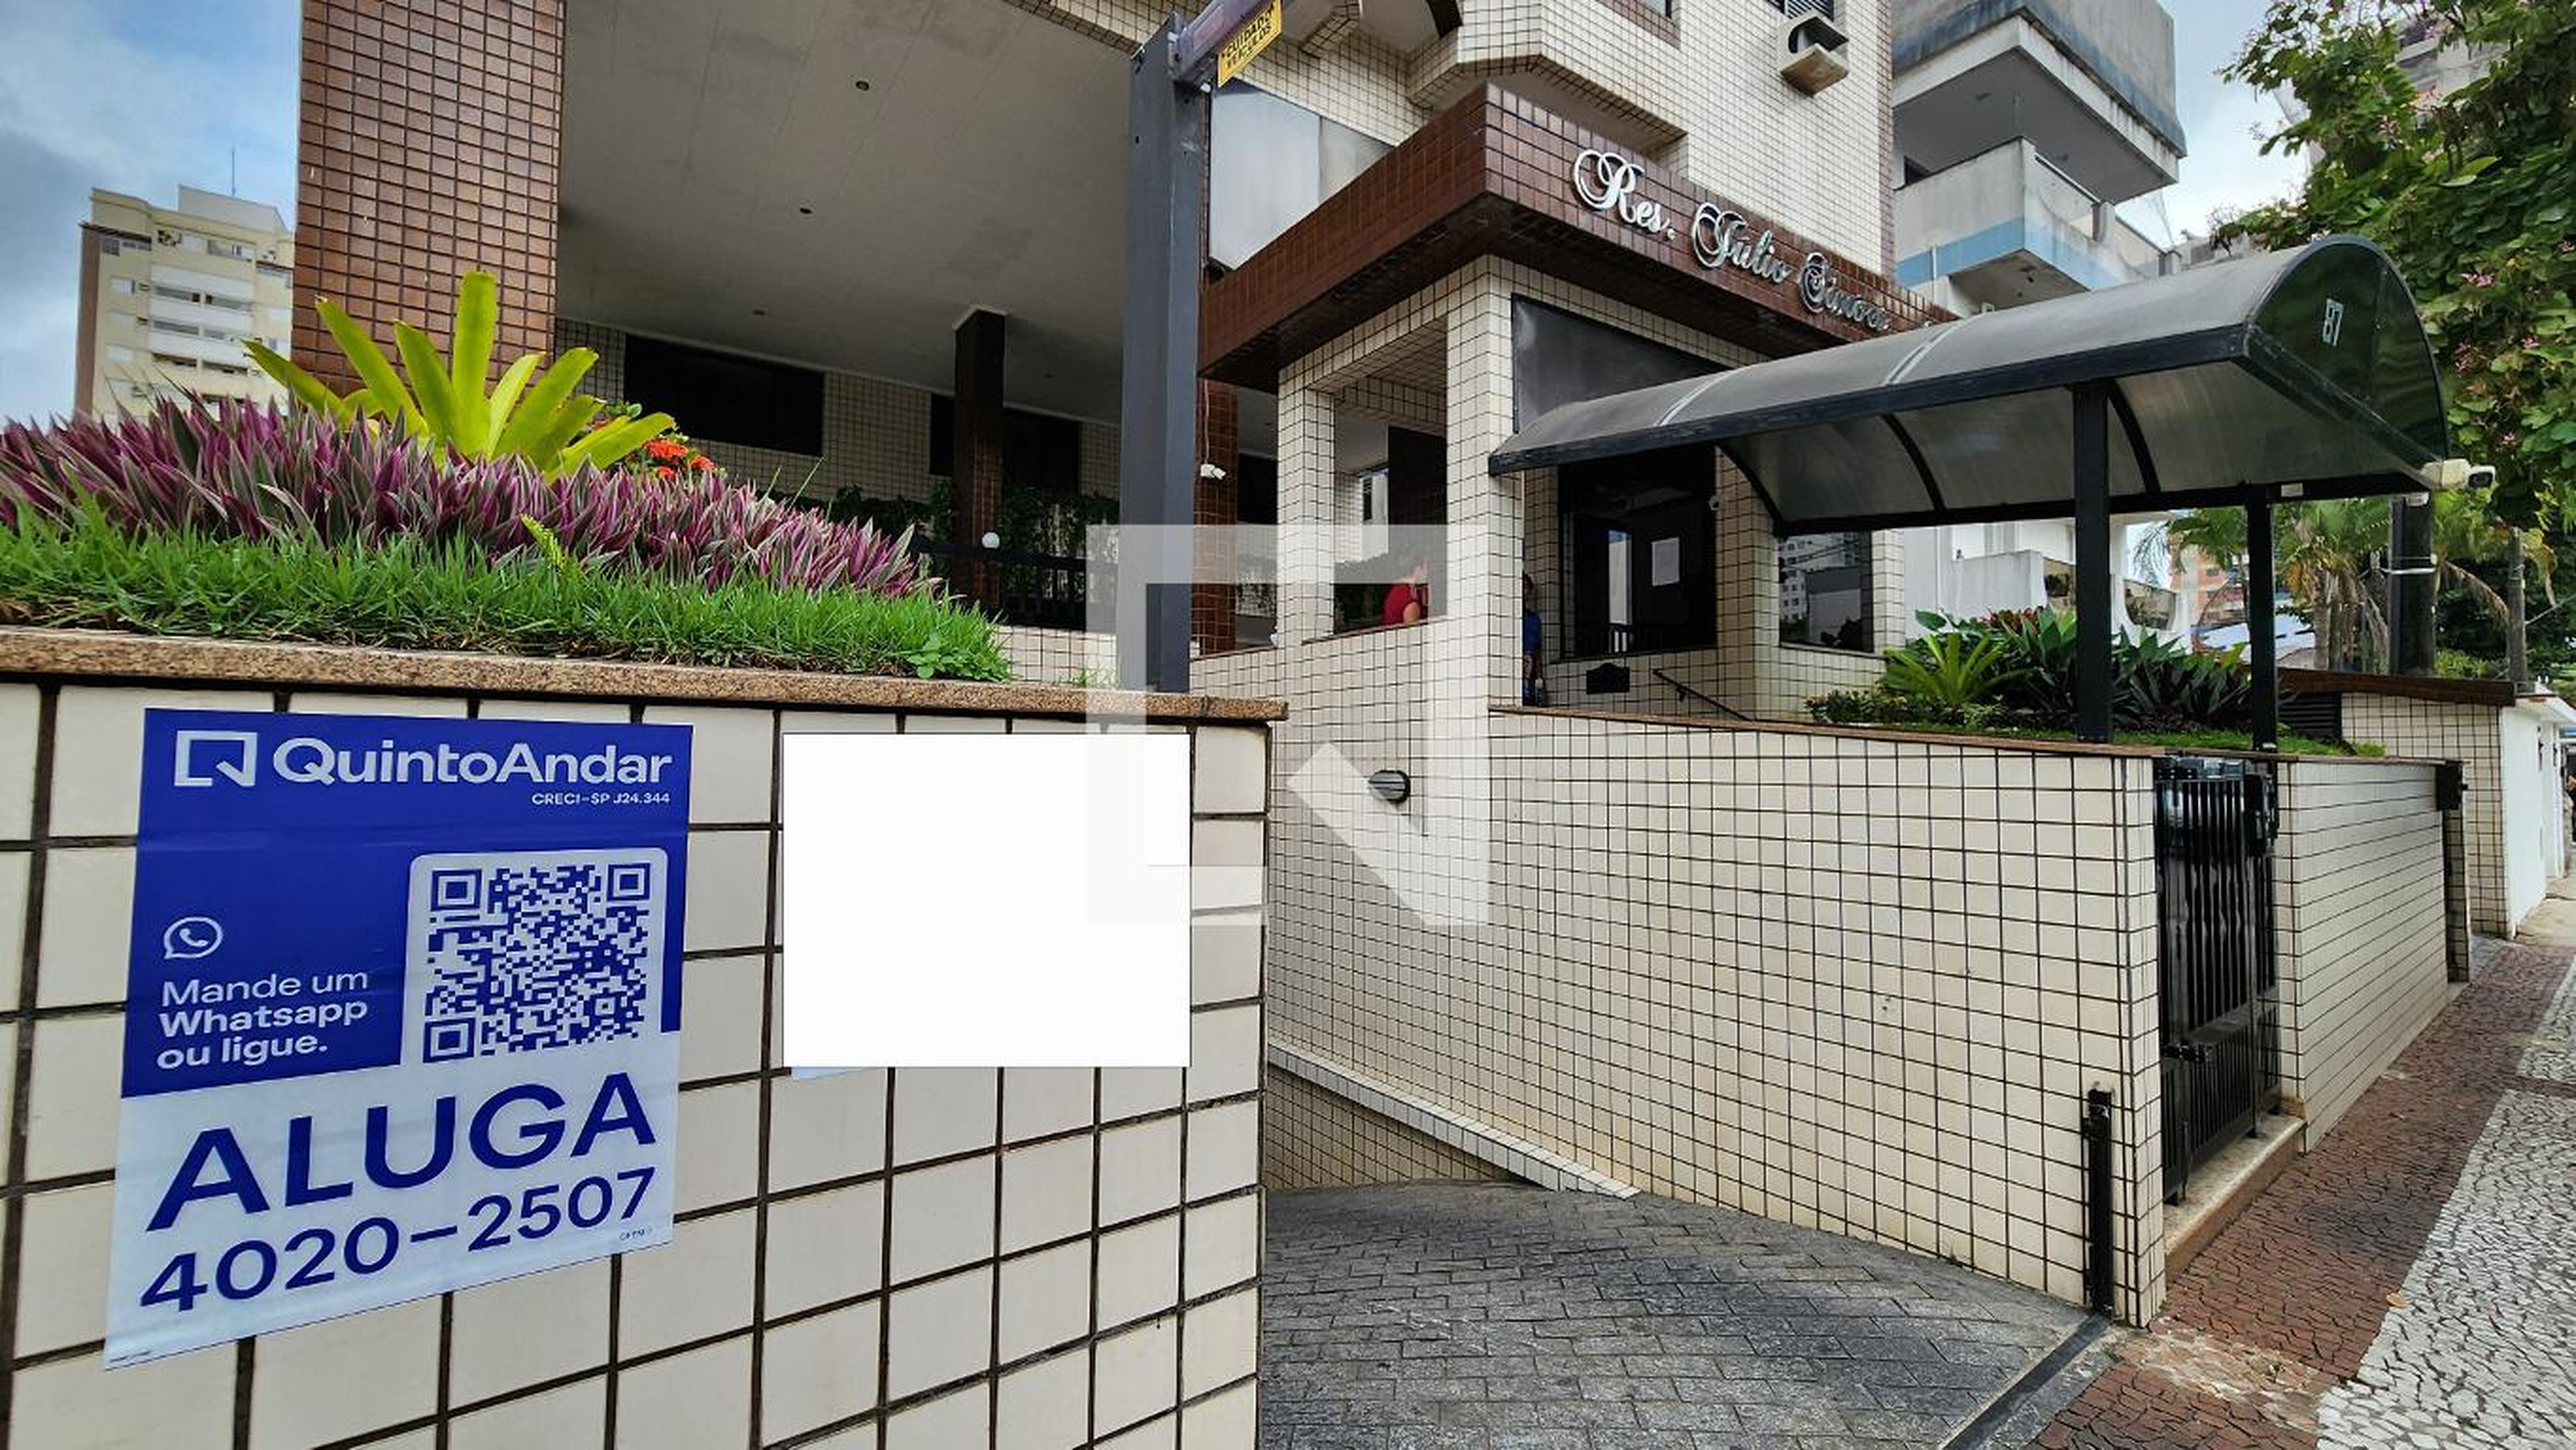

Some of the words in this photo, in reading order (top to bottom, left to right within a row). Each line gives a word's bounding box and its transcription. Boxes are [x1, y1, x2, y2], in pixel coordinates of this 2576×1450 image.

[1574, 150, 1677, 241] Res.
[272, 737, 673, 785] QuintoAndar
[531, 792, 610, 805] CRECI-SP
[613, 792, 670, 804] J24.344
[162, 974, 301, 1007] Mande
[311, 969, 368, 995] um
[160, 997, 368, 1038] Whatsapp
[156, 1046, 210, 1070] ou
[222, 1034, 327, 1068] ligue.
[146, 1072, 657, 1232] ALUGA
[140, 1166, 657, 1313] 4020-2507
